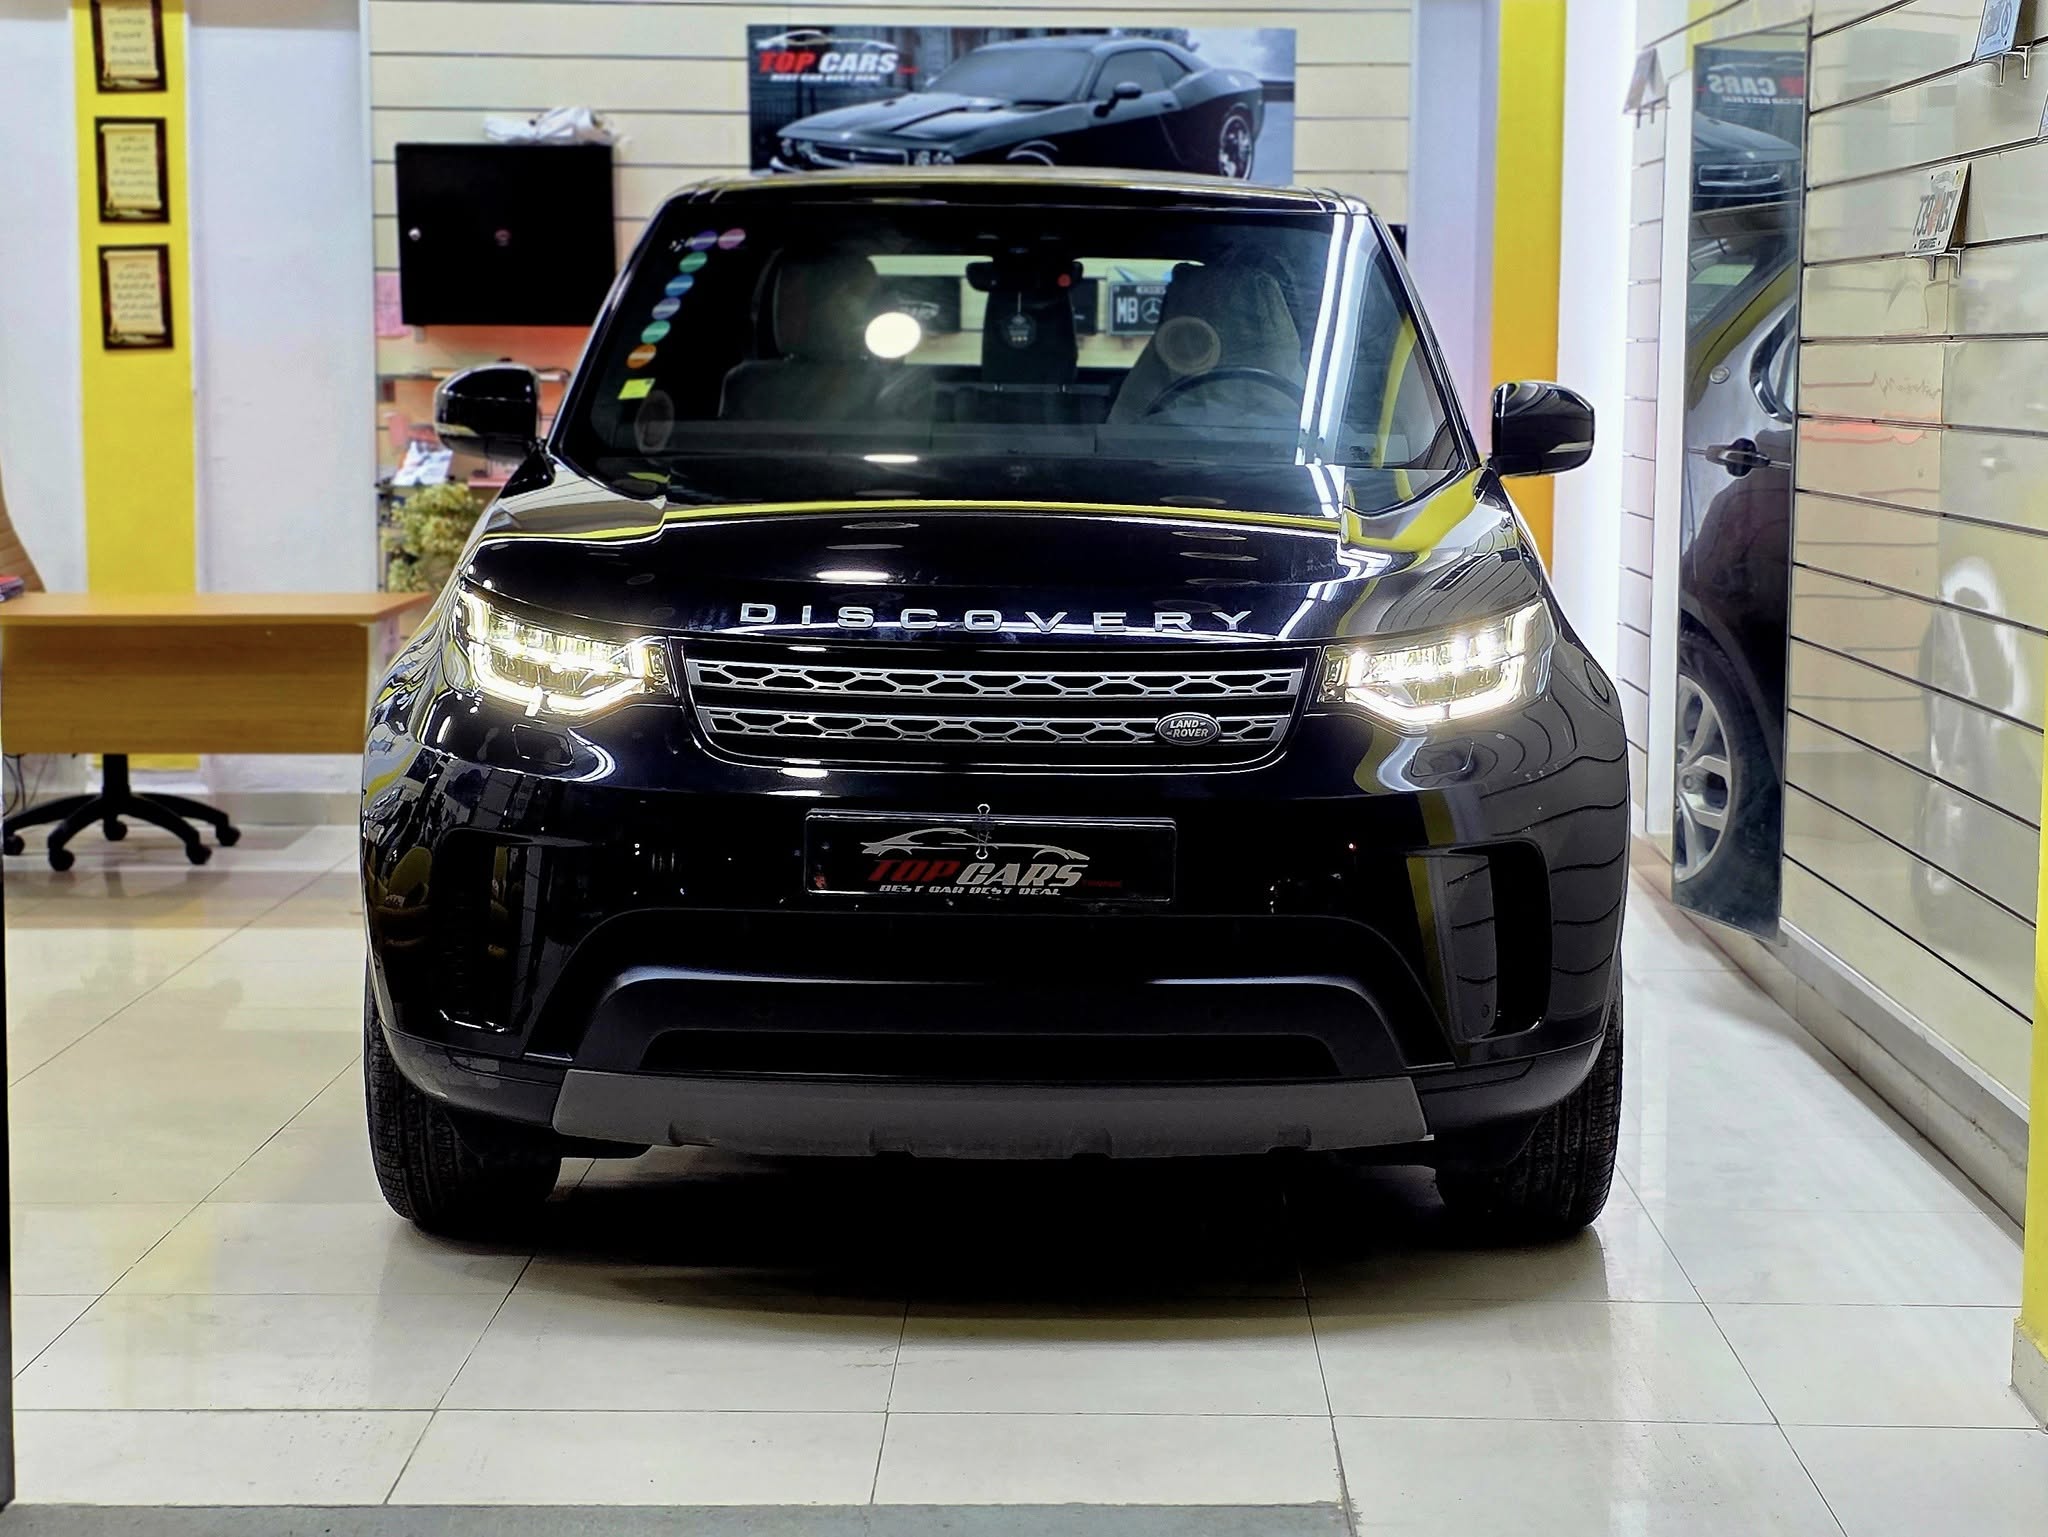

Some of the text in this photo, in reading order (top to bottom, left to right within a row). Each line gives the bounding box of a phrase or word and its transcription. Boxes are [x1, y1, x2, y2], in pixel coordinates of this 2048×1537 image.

[759, 52, 899, 74] TOP CARS
[1117, 297, 1138, 323] MB
[739, 602, 1252, 633] DISCOVERY
[1169, 719, 1199, 728] LAND
[1172, 728, 1209, 738] ROVER
[868, 859, 1089, 887] TOP CARS
[879, 884, 924, 893] BEST
[1018, 886, 1061, 896] DEAL
